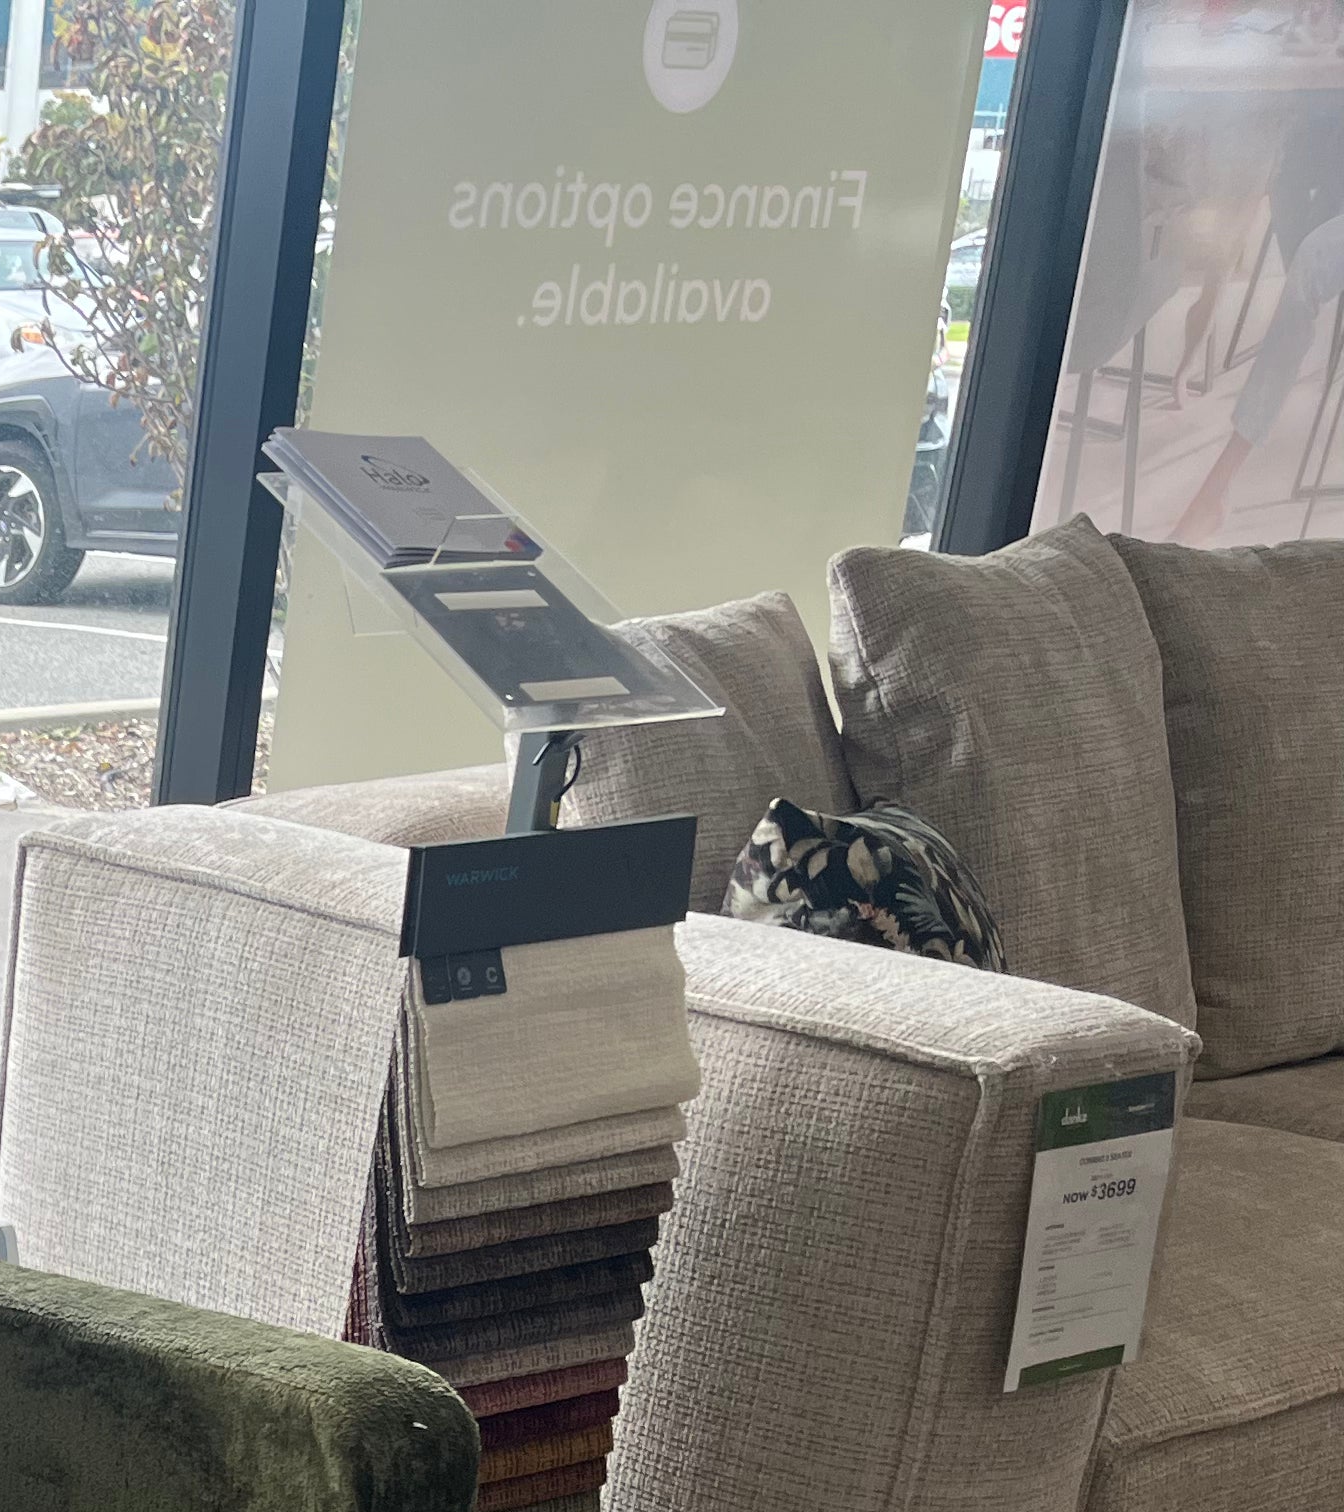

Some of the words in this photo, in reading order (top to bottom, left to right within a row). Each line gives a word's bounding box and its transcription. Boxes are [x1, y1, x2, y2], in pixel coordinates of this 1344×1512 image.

[446, 865, 519, 886] WARWICK
[1063, 1191, 1089, 1204] NOW
[1090, 1178, 1136, 1200] $3699
